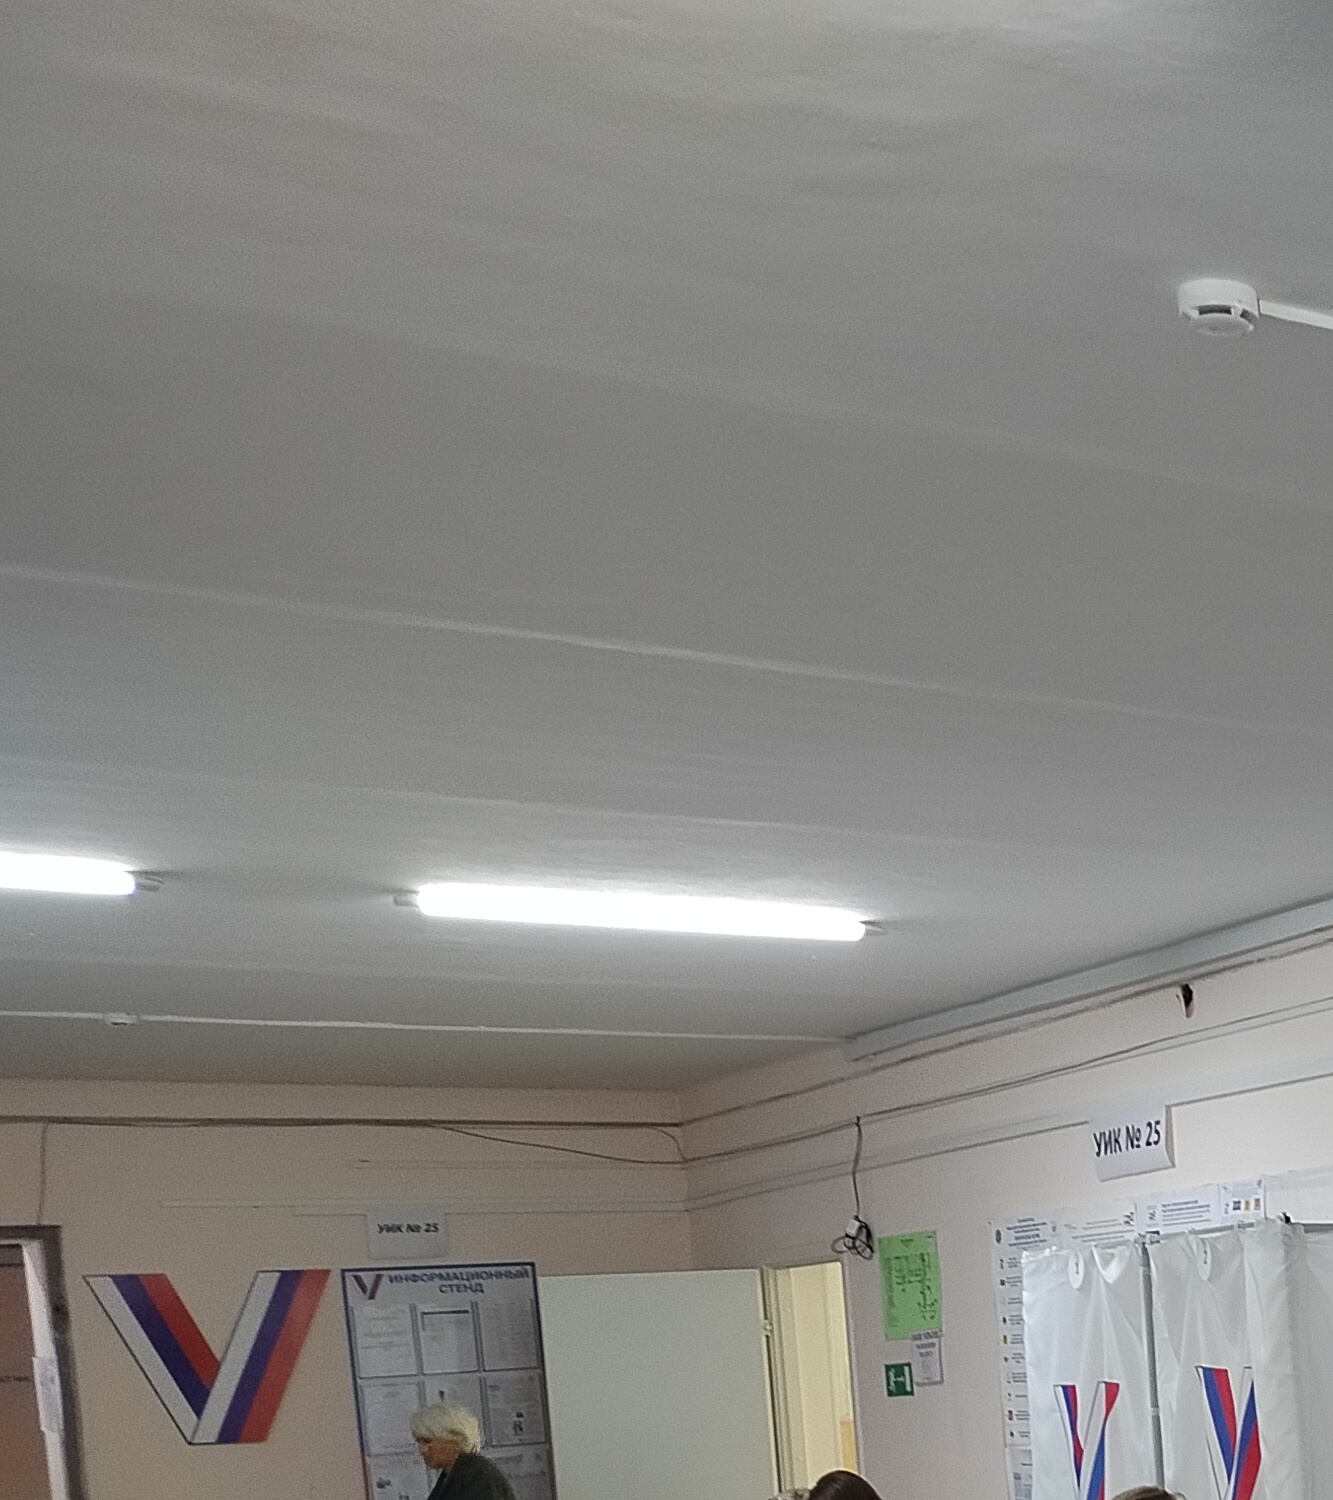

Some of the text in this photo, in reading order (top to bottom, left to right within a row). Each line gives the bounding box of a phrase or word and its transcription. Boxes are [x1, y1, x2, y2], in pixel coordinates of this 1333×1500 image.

[1092, 1119, 1161, 1157] УИК № 25
[424, 1222, 440, 1234] 25
[388, 1267, 530, 1285] ИНФОРМАЦИОННЫЙ
[438, 1282, 485, 1295] СТЕНД
